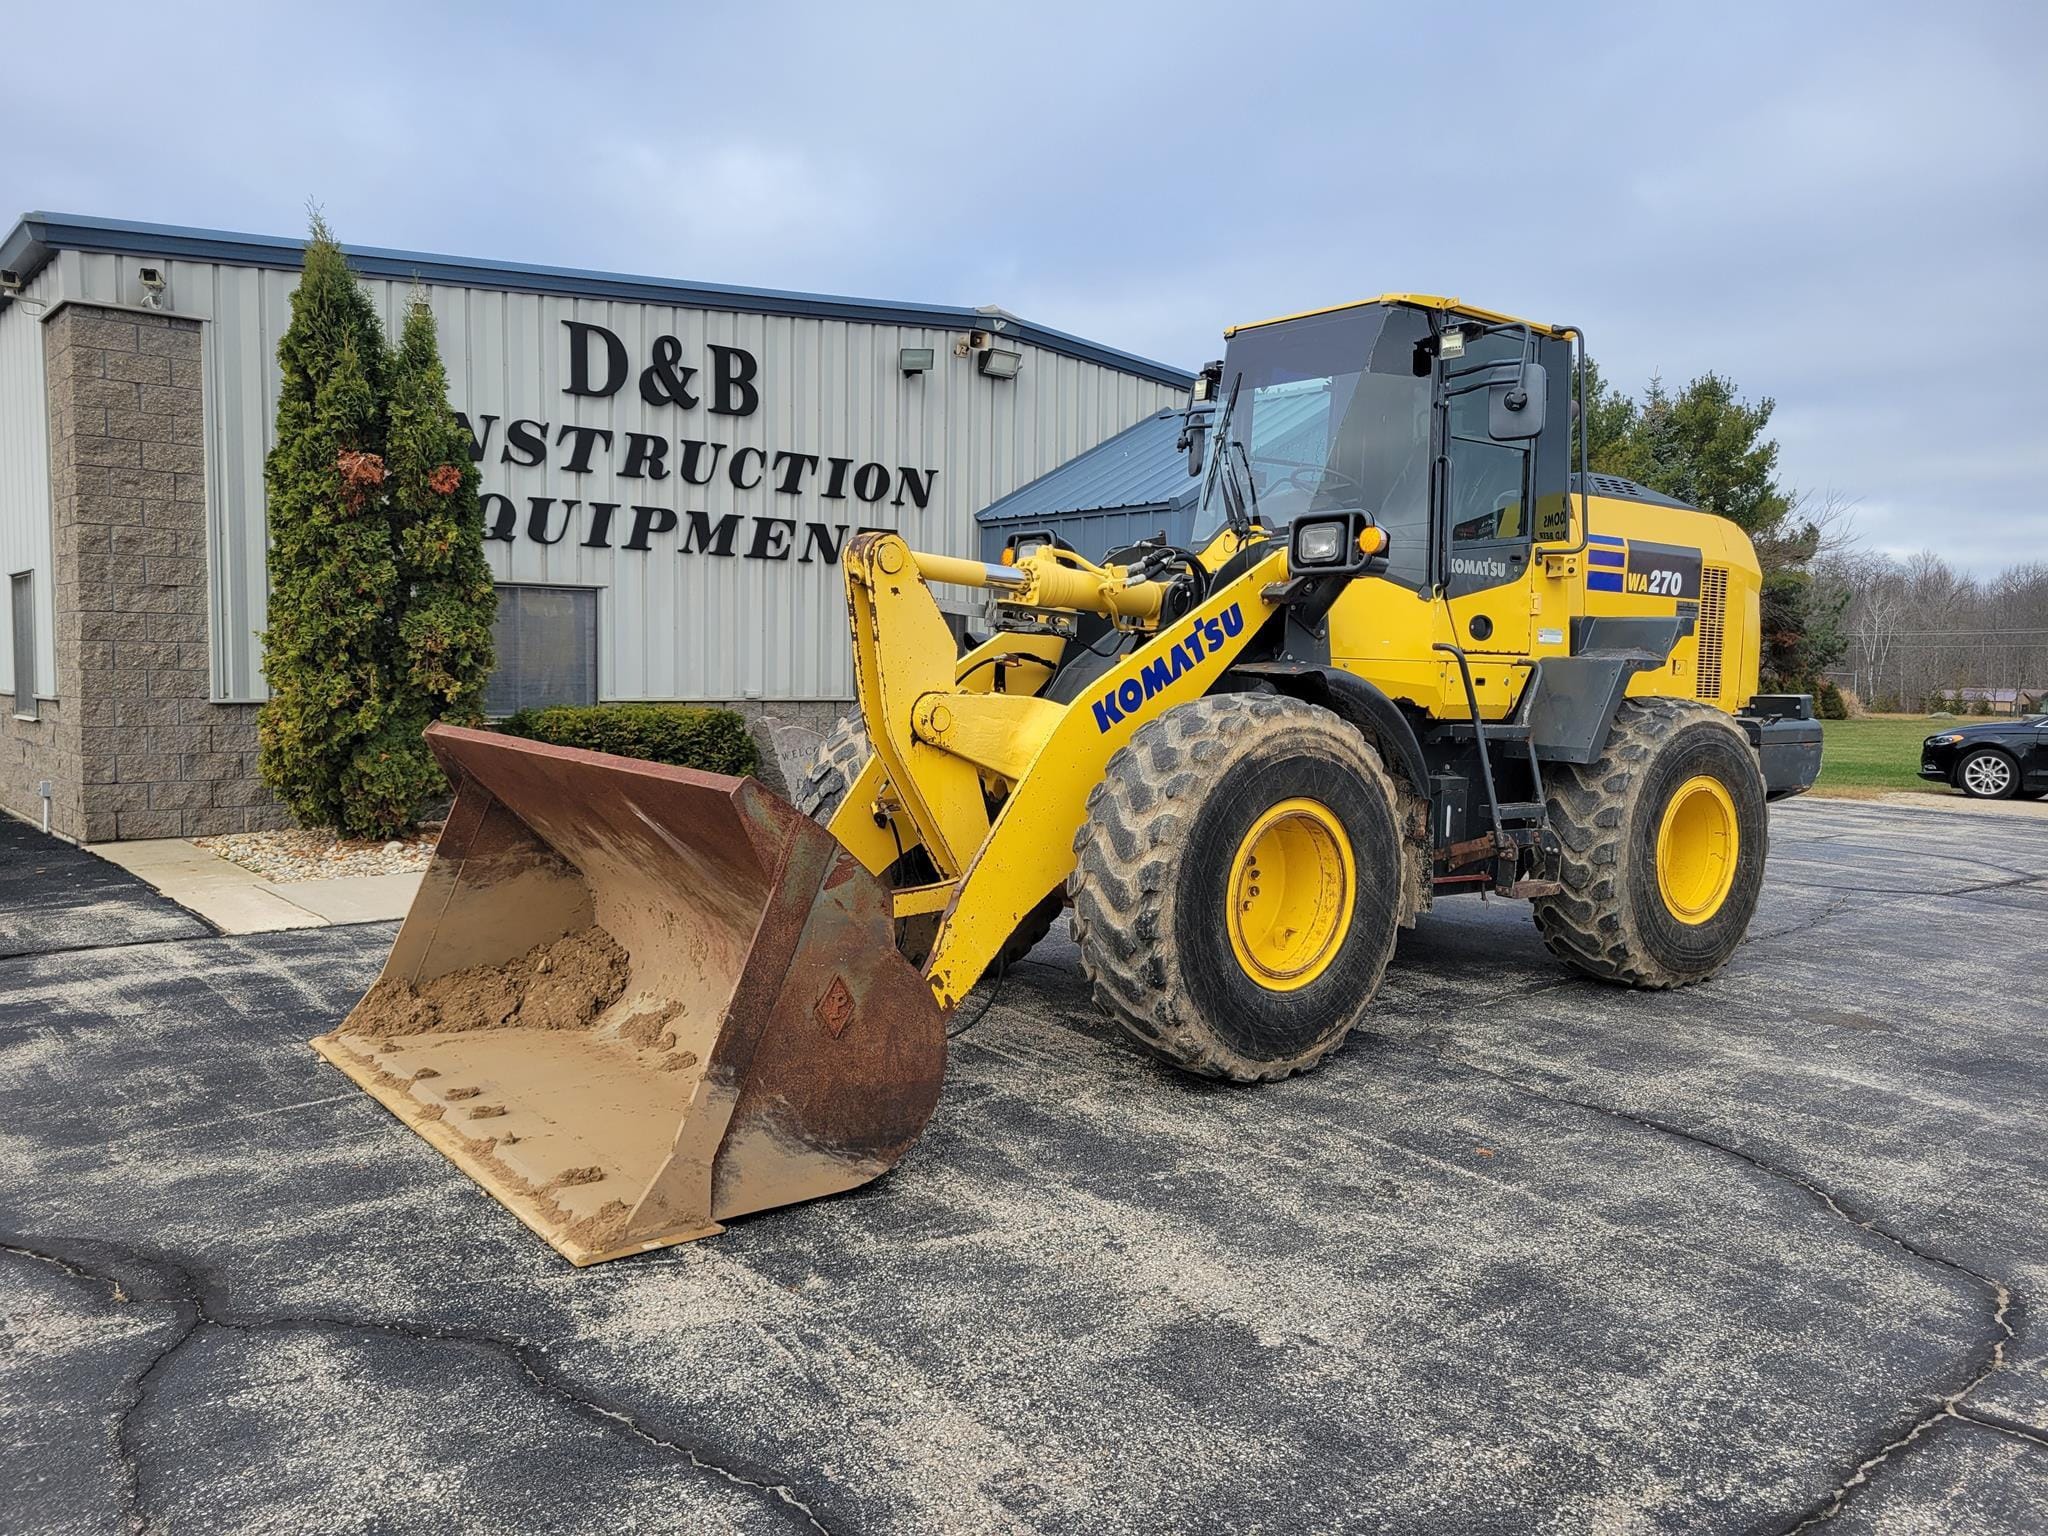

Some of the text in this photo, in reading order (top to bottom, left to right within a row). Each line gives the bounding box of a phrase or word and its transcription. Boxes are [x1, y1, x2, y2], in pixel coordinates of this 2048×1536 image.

[561, 319, 759, 416] D&B
[455, 411, 939, 508] NSTRUCTION
[478, 492, 898, 565] QUIPMEN
[1628, 569, 1682, 596] WA270
[1091, 602, 1244, 734] KOMATSU
[782, 746, 819, 761] WELC
